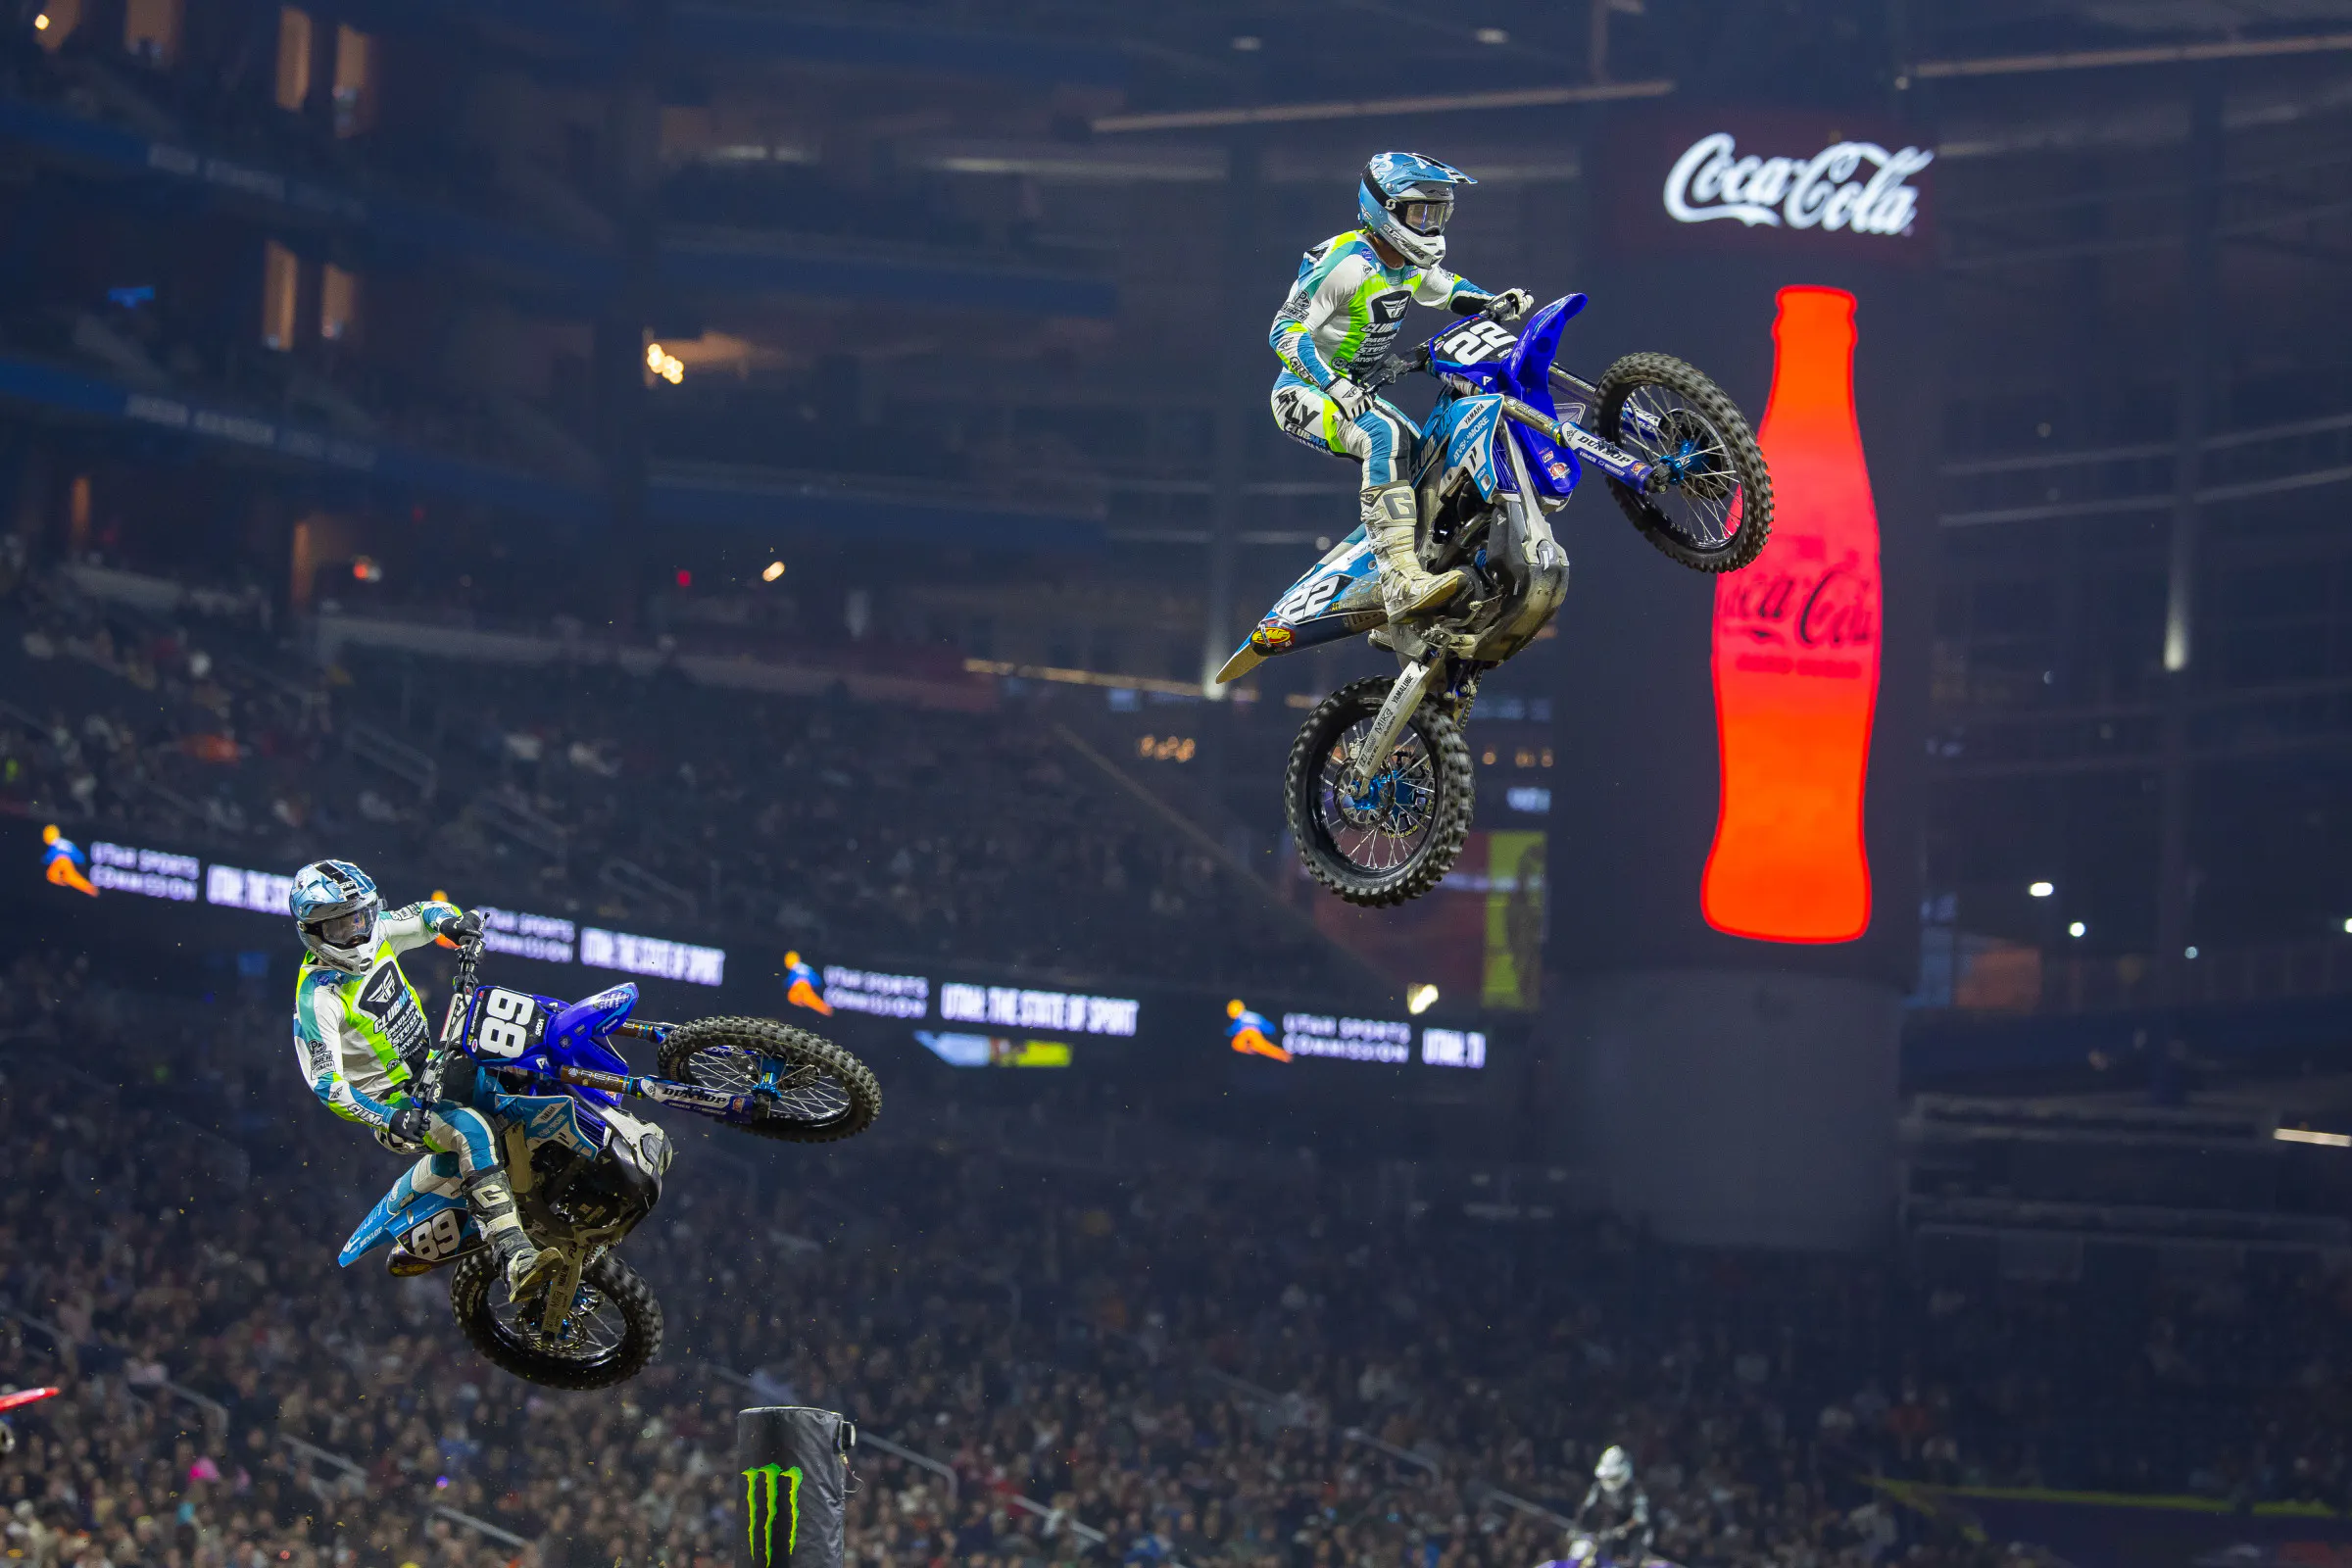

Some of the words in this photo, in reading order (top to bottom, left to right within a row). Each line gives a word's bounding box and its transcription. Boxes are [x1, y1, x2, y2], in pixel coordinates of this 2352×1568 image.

[1663, 131, 1935, 235] Coca-Cola
[1443, 320, 1519, 366] 22
[1463, 403, 1485, 425] YAMAHA
[1280, 575, 1339, 625] 22
[1391, 673, 1414, 704] YAMALUBE
[137, 849, 200, 881] SPORTS
[518, 912, 575, 944] SPORTS
[863, 971, 929, 1001] SPORTS
[478, 988, 535, 1058] 89
[1338, 1016, 1412, 1046] SPORTS
[1282, 1032, 1409, 1063] COMMISSION
[359, 1226, 383, 1248] DUNLOP
[412, 1208, 462, 1261] 89
